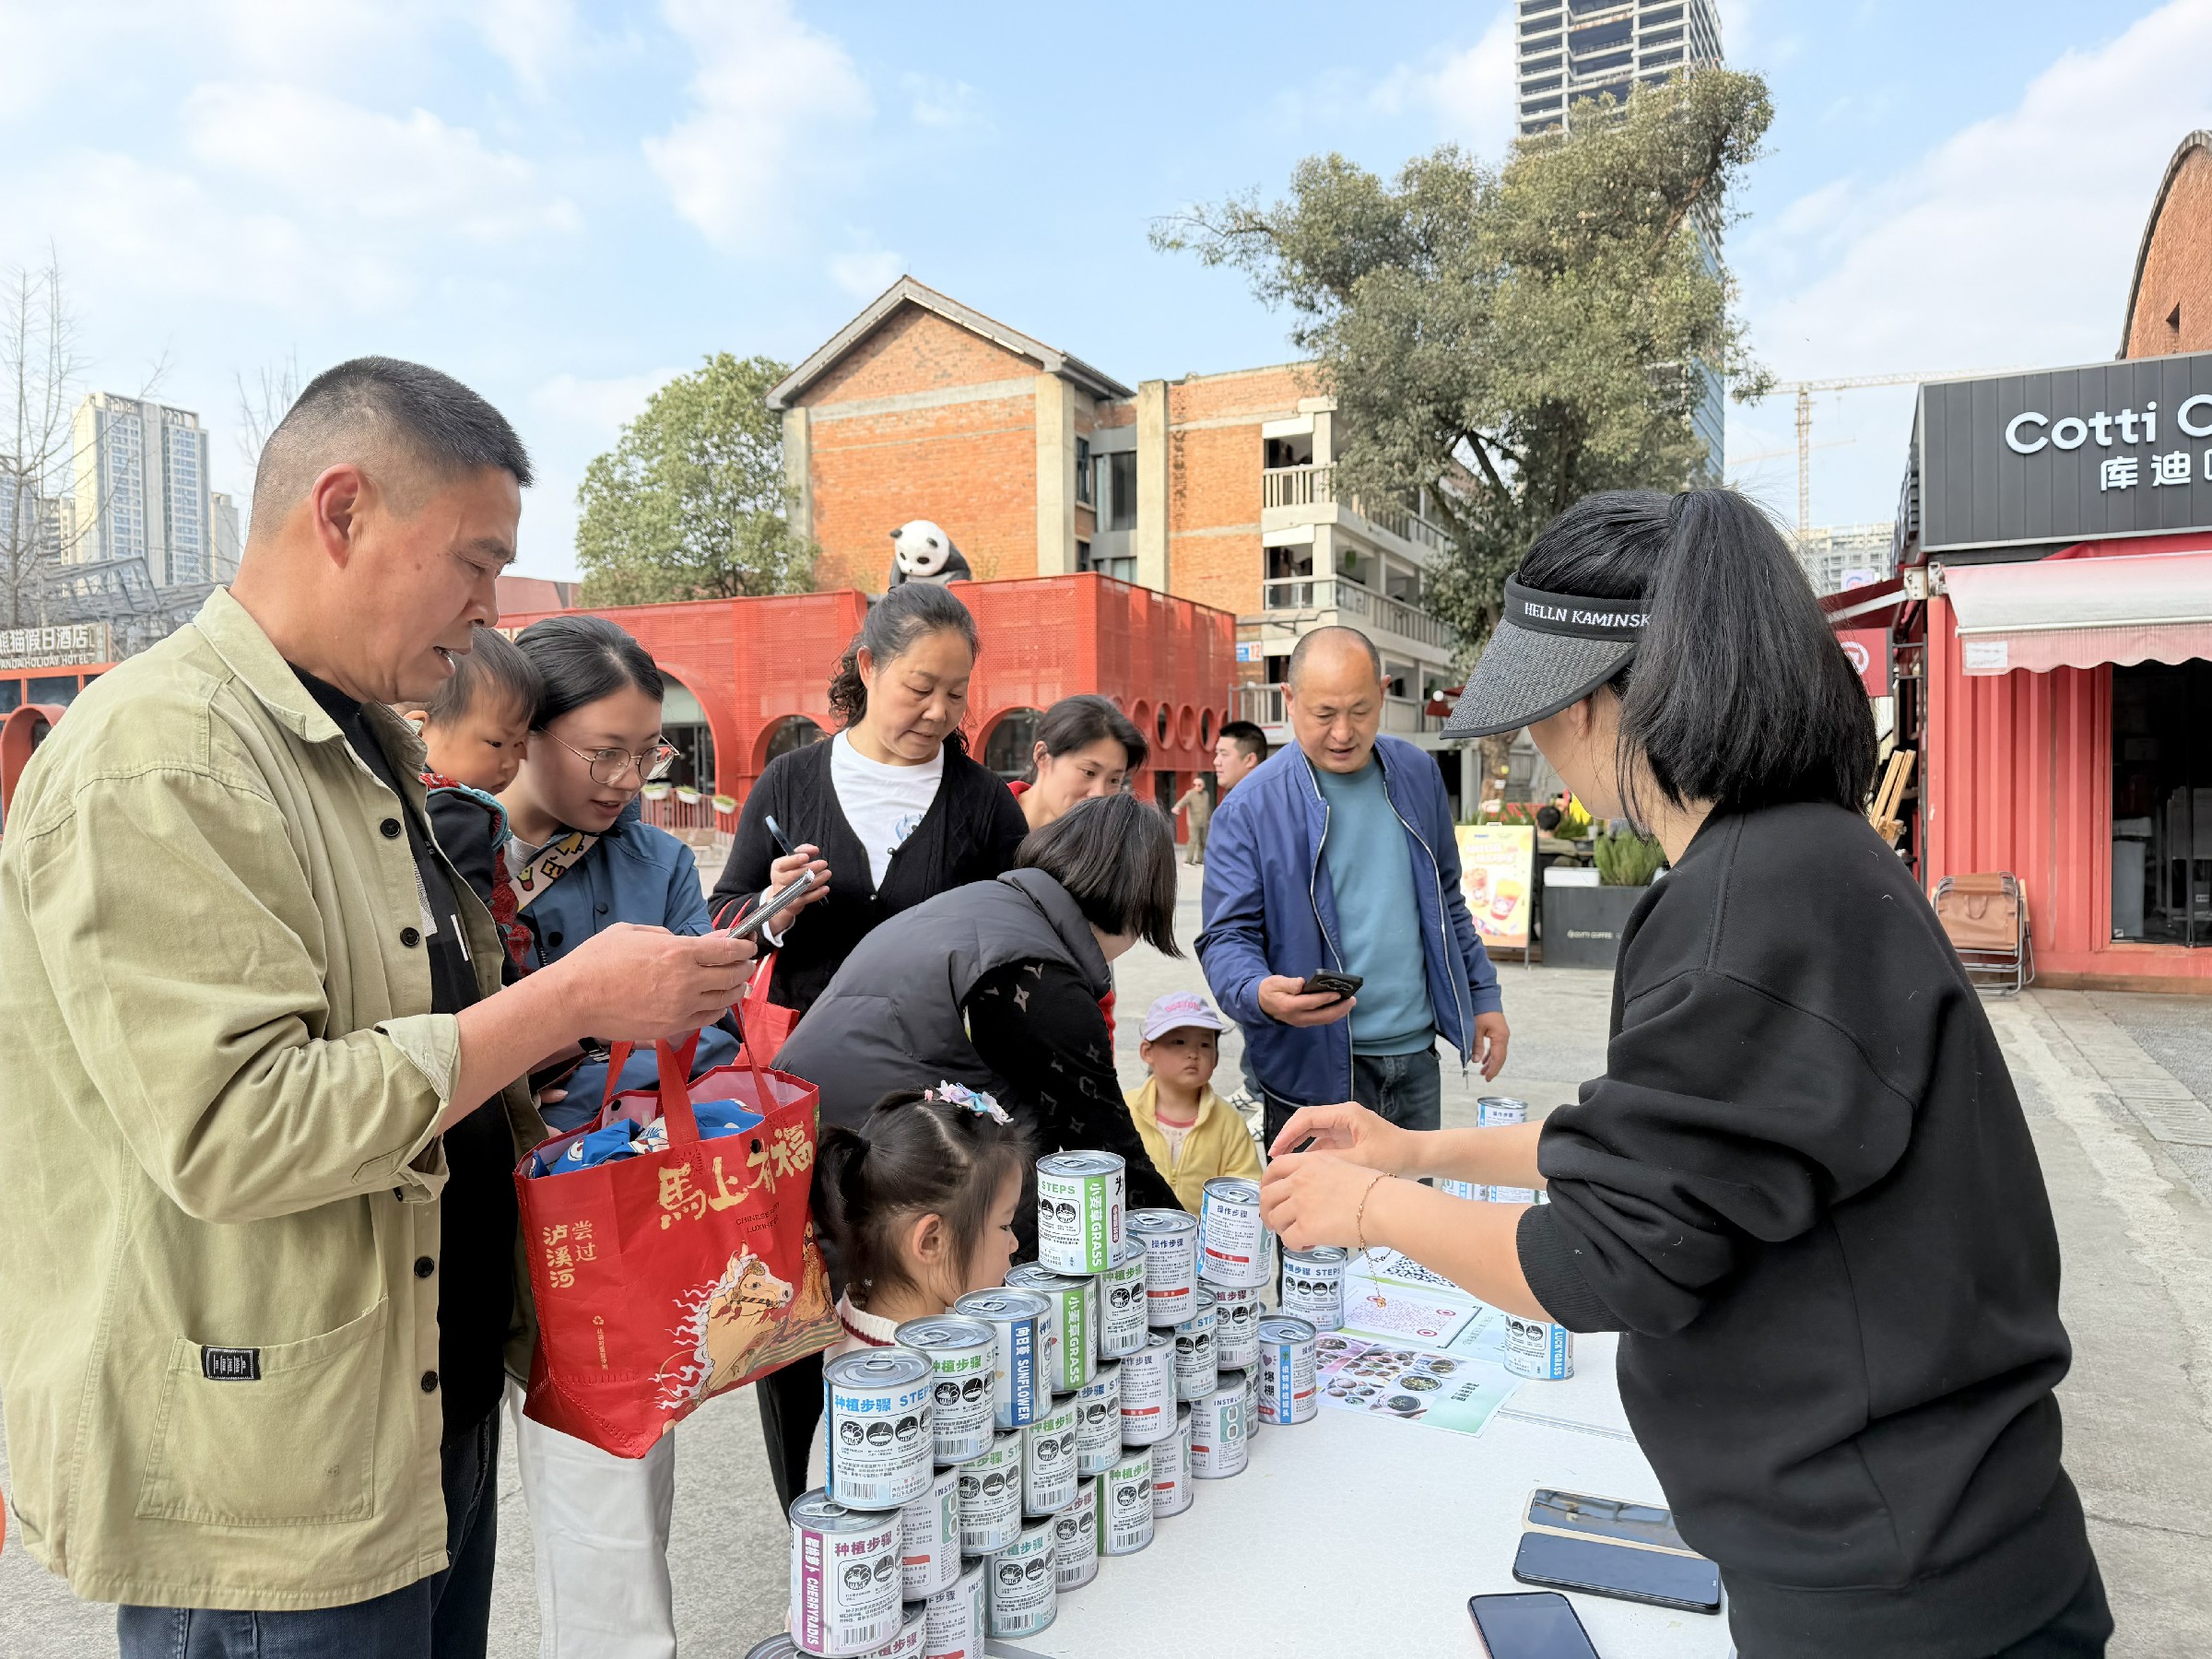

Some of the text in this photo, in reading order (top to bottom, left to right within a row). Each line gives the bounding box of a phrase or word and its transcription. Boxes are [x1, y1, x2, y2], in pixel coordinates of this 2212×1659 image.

[2006, 401, 2158, 454] Cotti
[2100, 449, 2212, 492] 库迪
[1524, 602, 1568, 622] HELLN
[0, 653, 89, 670] ANDA HOLIDAY HOTEL
[1041, 1180, 1076, 1195] STEPS
[1217, 1205, 1248, 1218] 操作步骤
[571, 1220, 598, 1262] 尝过
[1151, 1238, 1184, 1249] 操作步骤
[542, 1224, 576, 1288] 泸溪河
[1102, 1263, 1143, 1283] 种植步骤
[1315, 1267, 1341, 1277] STEPS
[1553, 1331, 1564, 1376] LUCKYGRASS
[1017, 1359, 1031, 1421] SUNFLOWER
[834, 1394, 892, 1413] 种植步骤
[1109, 1459, 1150, 1481] 种植步骤
[834, 1530, 892, 1558] 种植步骤
[806, 1577, 819, 1646] CHERRYRADIS
